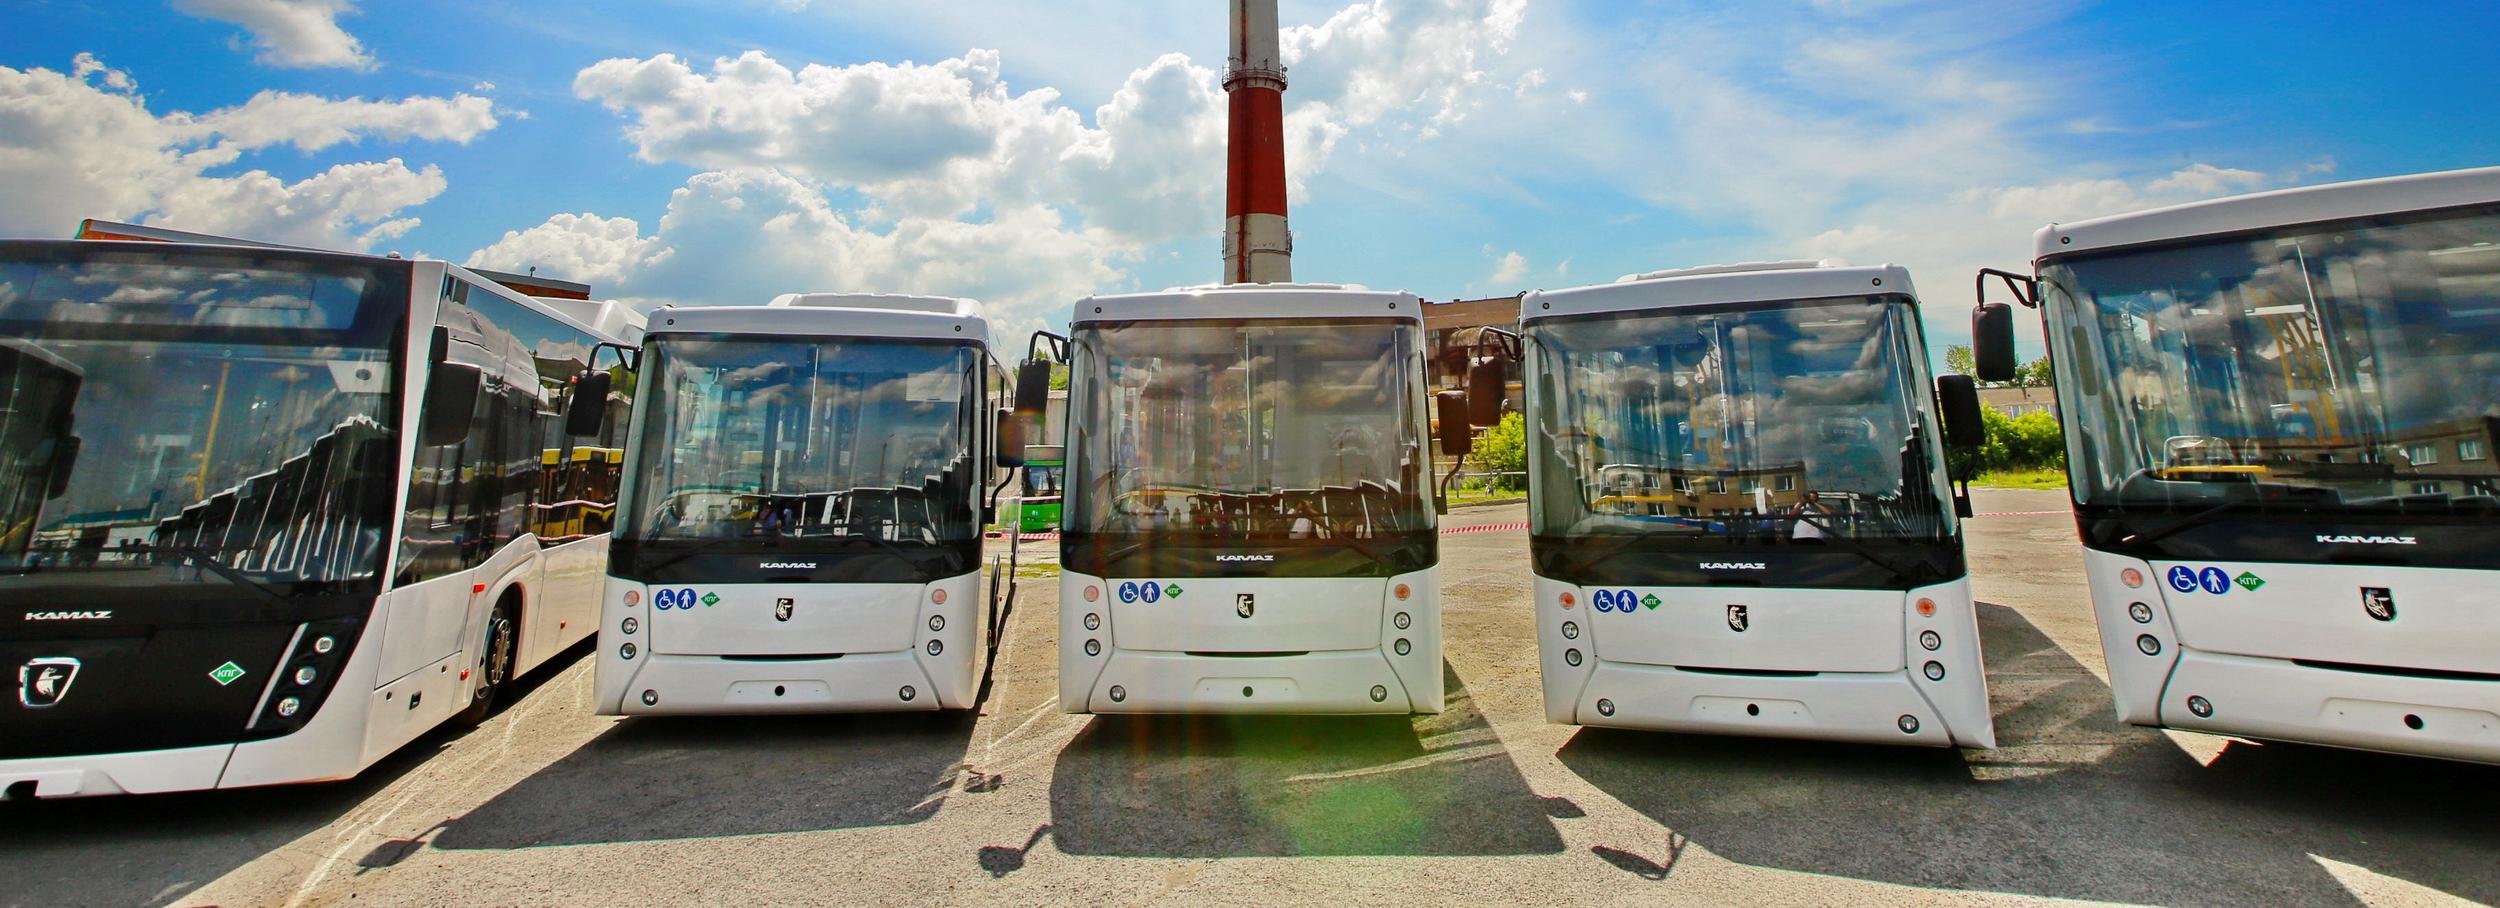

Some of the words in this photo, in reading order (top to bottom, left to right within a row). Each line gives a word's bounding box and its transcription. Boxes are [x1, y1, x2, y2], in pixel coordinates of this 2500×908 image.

[2316, 535, 2417, 545] KAMAZ
[2239, 577, 2258, 585] КПГ
[25, 611, 112, 620] KAMAZ
[217, 669, 236, 678] КПГ
